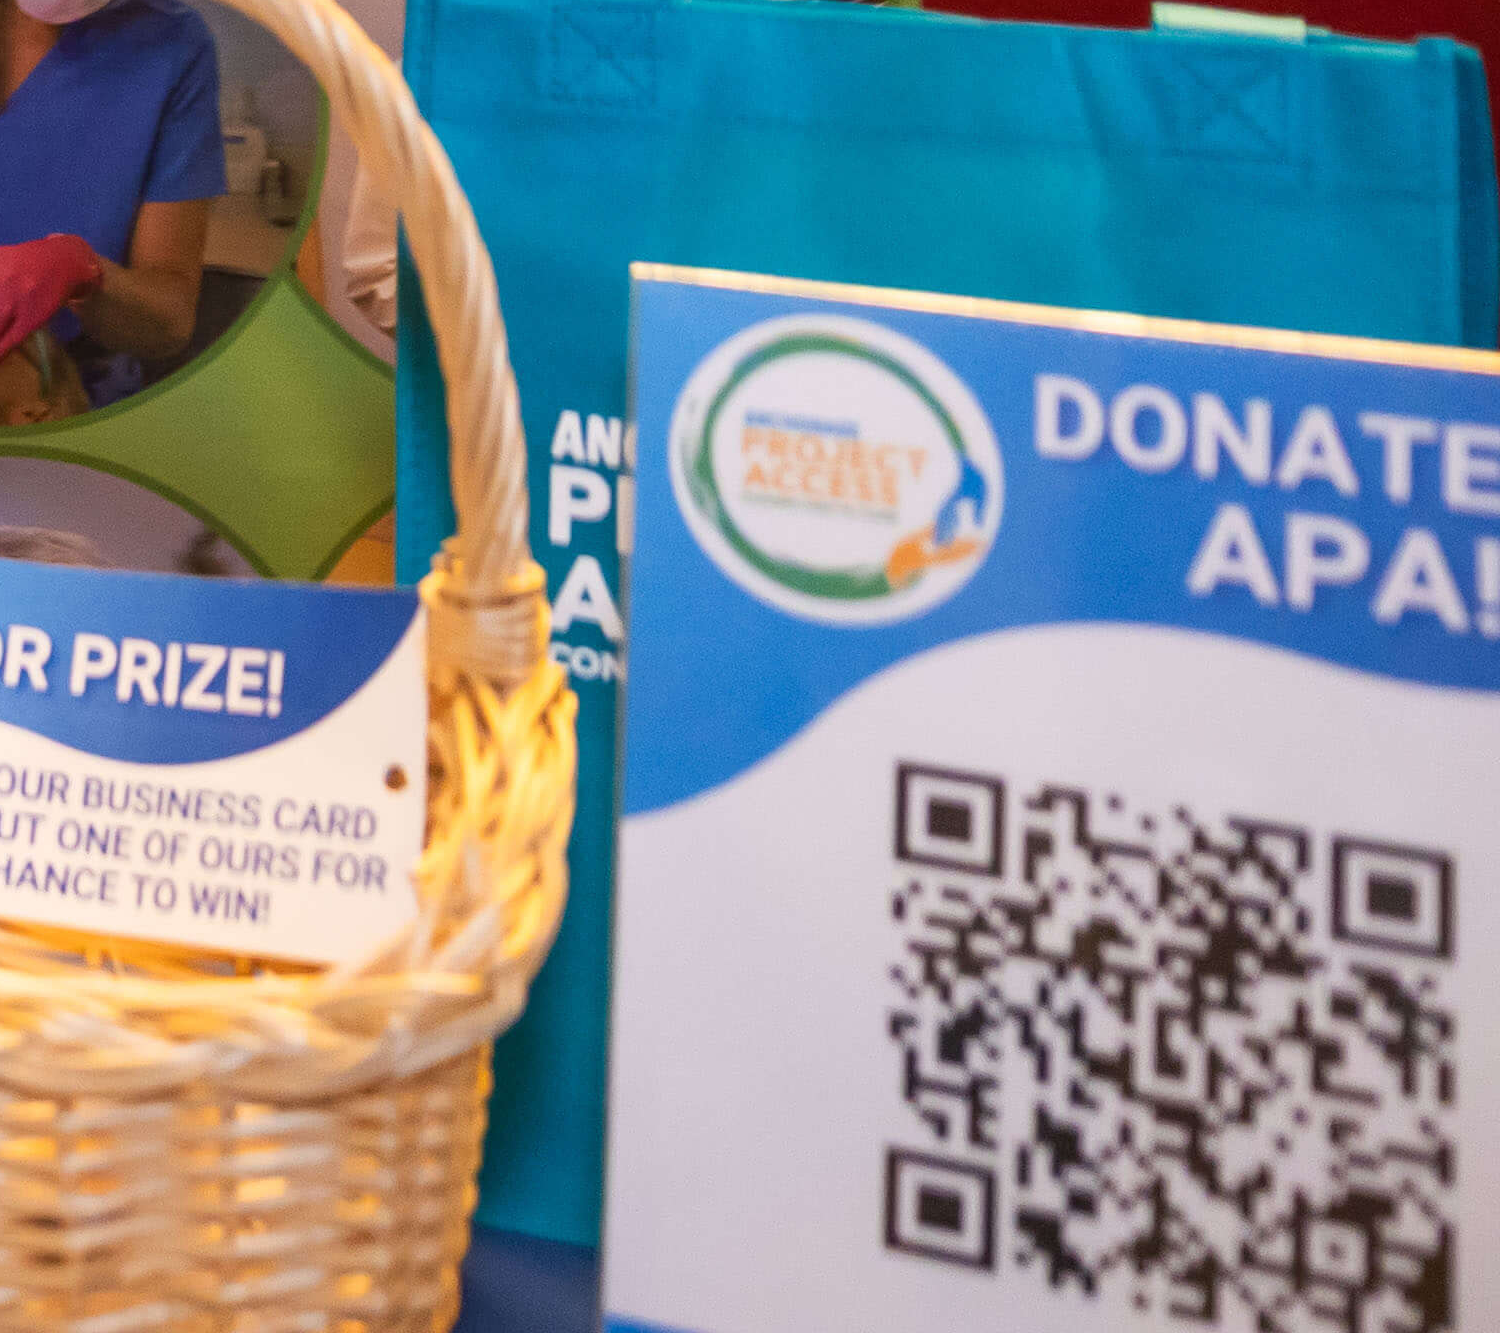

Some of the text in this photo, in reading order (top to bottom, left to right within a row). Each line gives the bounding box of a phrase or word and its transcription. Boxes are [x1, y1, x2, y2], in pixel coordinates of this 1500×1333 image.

[1034, 372, 1500, 517] DONATE
[1185, 502, 1500, 639] APA!
[68, 632, 287, 718] PRIZE!
[82, 775, 263, 829] BUSINESS
[274, 797, 378, 841] CARD
[57, 820, 132, 861] ONE
[143, 827, 188, 867] OF
[199, 835, 300, 881] OURS
[311, 851, 389, 893] FOR
[131, 873, 177, 913] TO
[188, 879, 271, 925] WIN!
